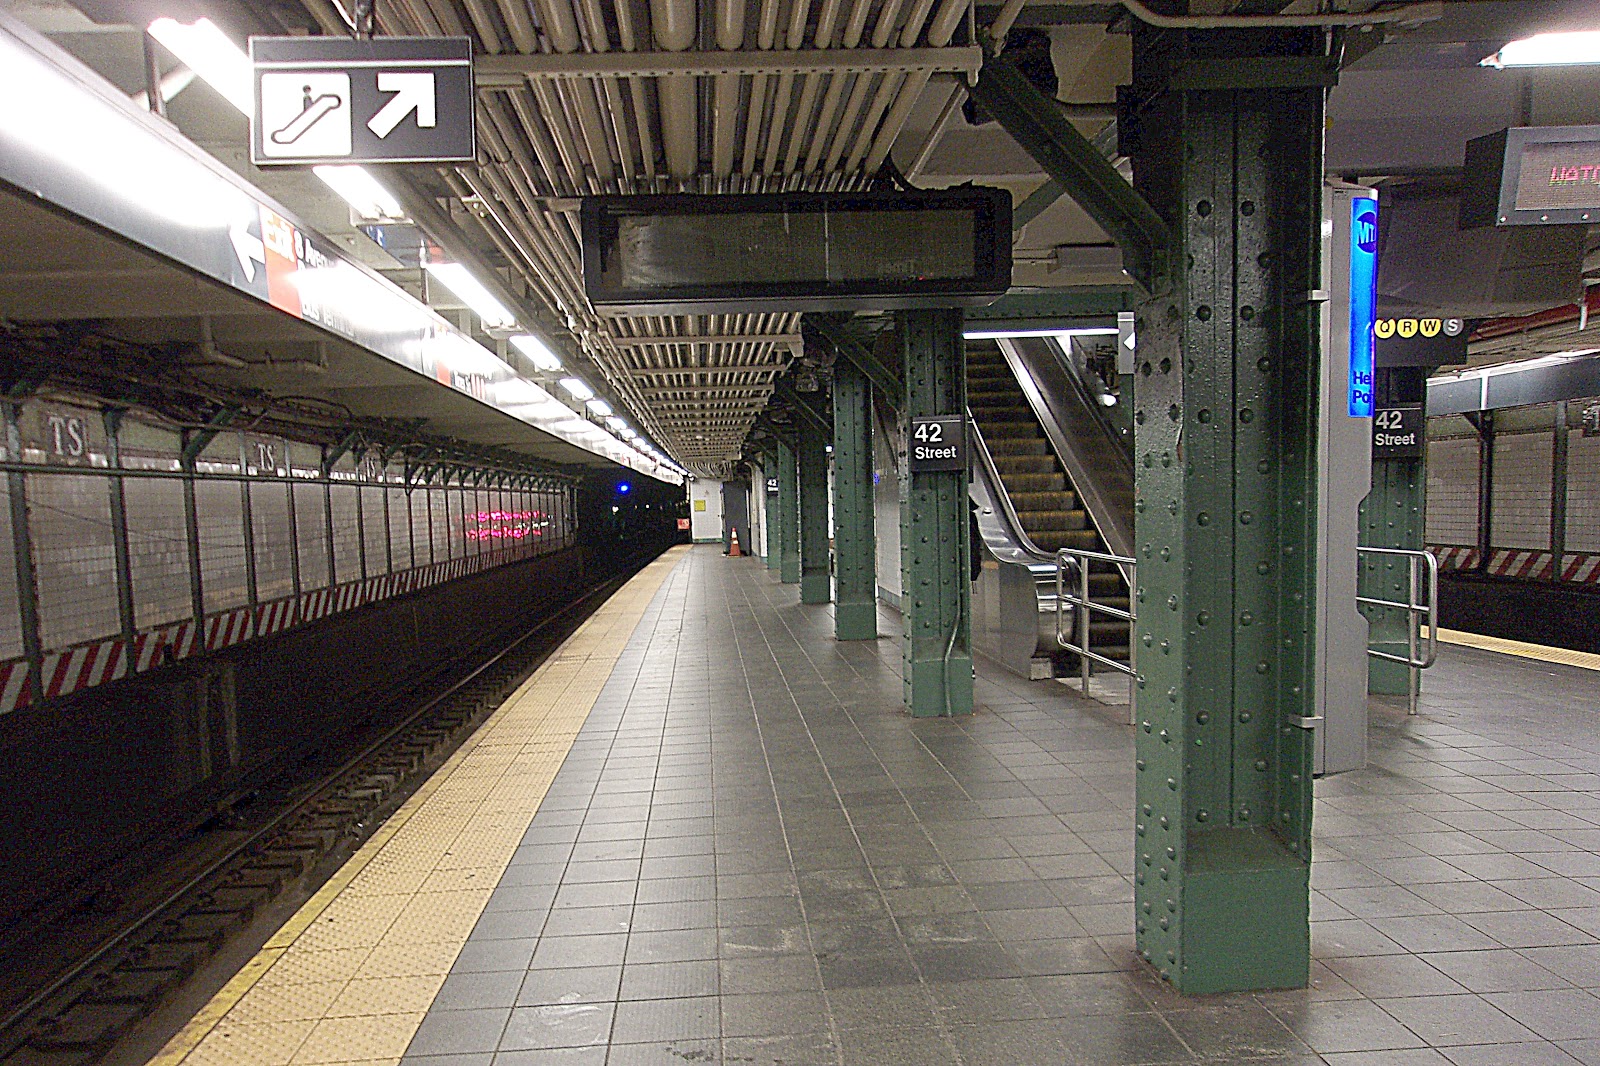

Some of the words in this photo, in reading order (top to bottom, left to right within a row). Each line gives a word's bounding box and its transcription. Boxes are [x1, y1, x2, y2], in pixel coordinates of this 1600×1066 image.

[1357, 221, 1375, 244] MT
[1380, 321, 1390, 333] Q
[1403, 321, 1412, 332] R
[1423, 320, 1437, 332] W
[1447, 319, 1458, 332] S
[1353, 370, 1372, 385] He
[1375, 411, 1403, 430] 42
[48, 416, 82, 456] TS
[914, 423, 943, 443] 42
[1375, 433, 1415, 446] Street
[257, 443, 274, 471] TS
[915, 445, 957, 460] Street
